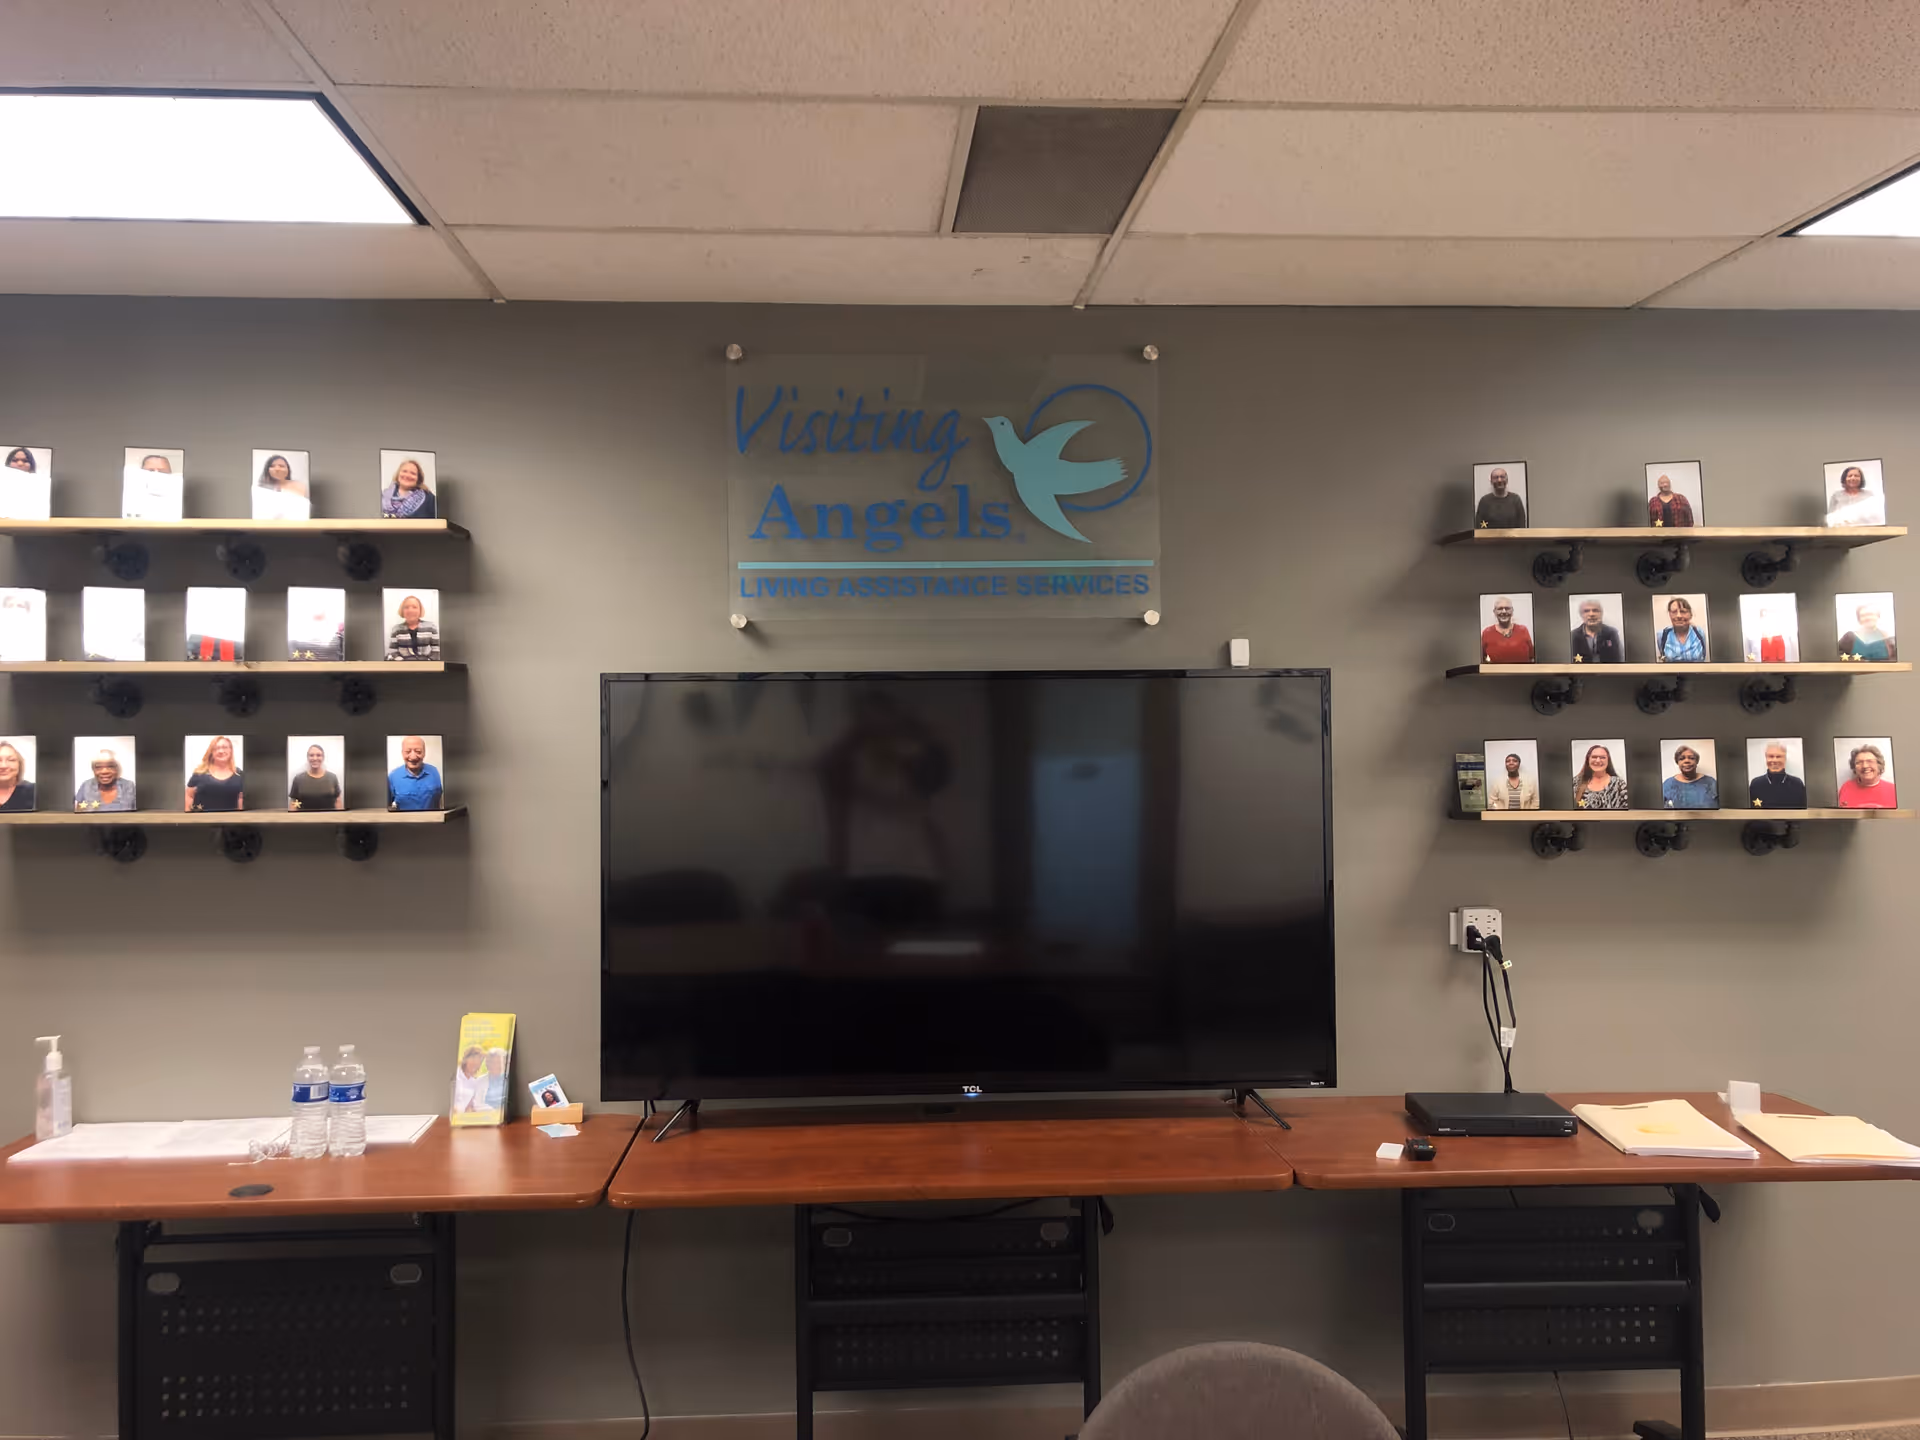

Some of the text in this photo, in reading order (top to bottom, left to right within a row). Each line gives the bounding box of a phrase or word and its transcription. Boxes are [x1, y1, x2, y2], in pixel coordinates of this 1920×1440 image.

[735, 385, 970, 492] Visiting
[749, 483, 1012, 553] Angels
[740, 574, 1150, 598] LIVING ASSISTANCE SERVICES
[962, 1085, 983, 1093] TCL
